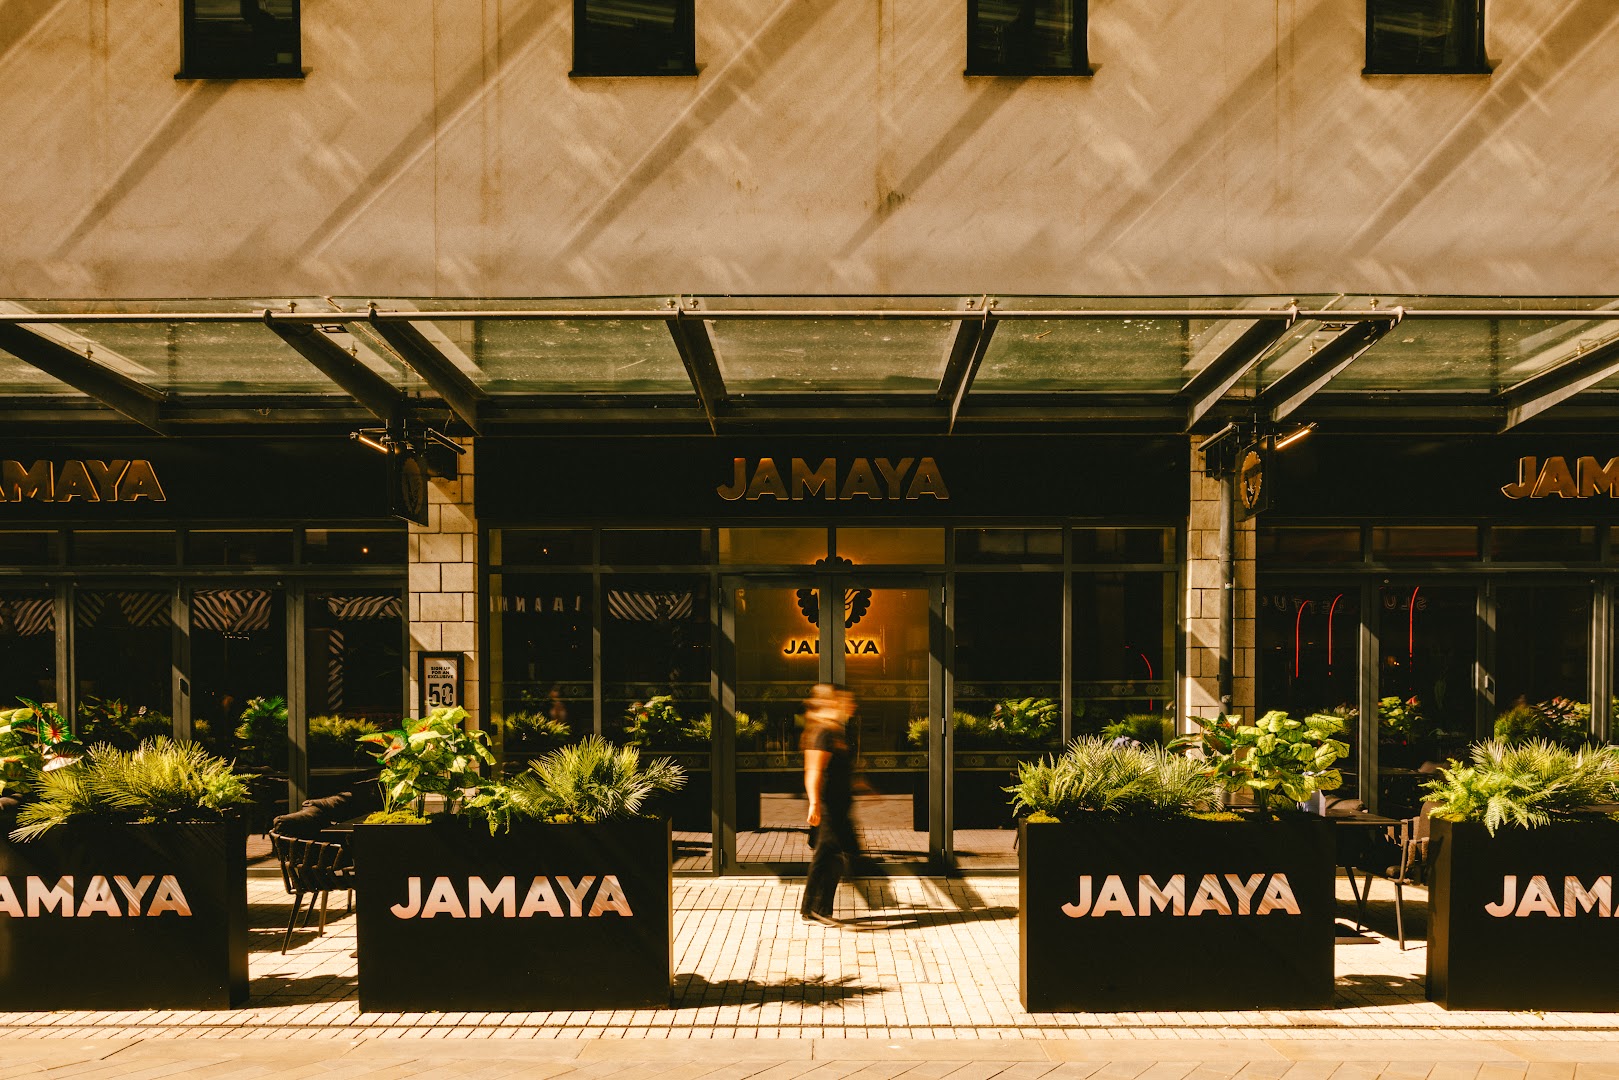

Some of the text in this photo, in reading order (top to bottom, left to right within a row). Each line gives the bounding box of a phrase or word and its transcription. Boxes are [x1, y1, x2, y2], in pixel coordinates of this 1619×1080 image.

[0, 459, 166, 503] MAYA
[716, 457, 950, 501] JAMAYA
[783, 639, 880, 655] JAYA
[390, 875, 634, 919] JAMAYA
[1061, 873, 1302, 918] JAMAYA
[1484, 875, 1619, 918] JAM
